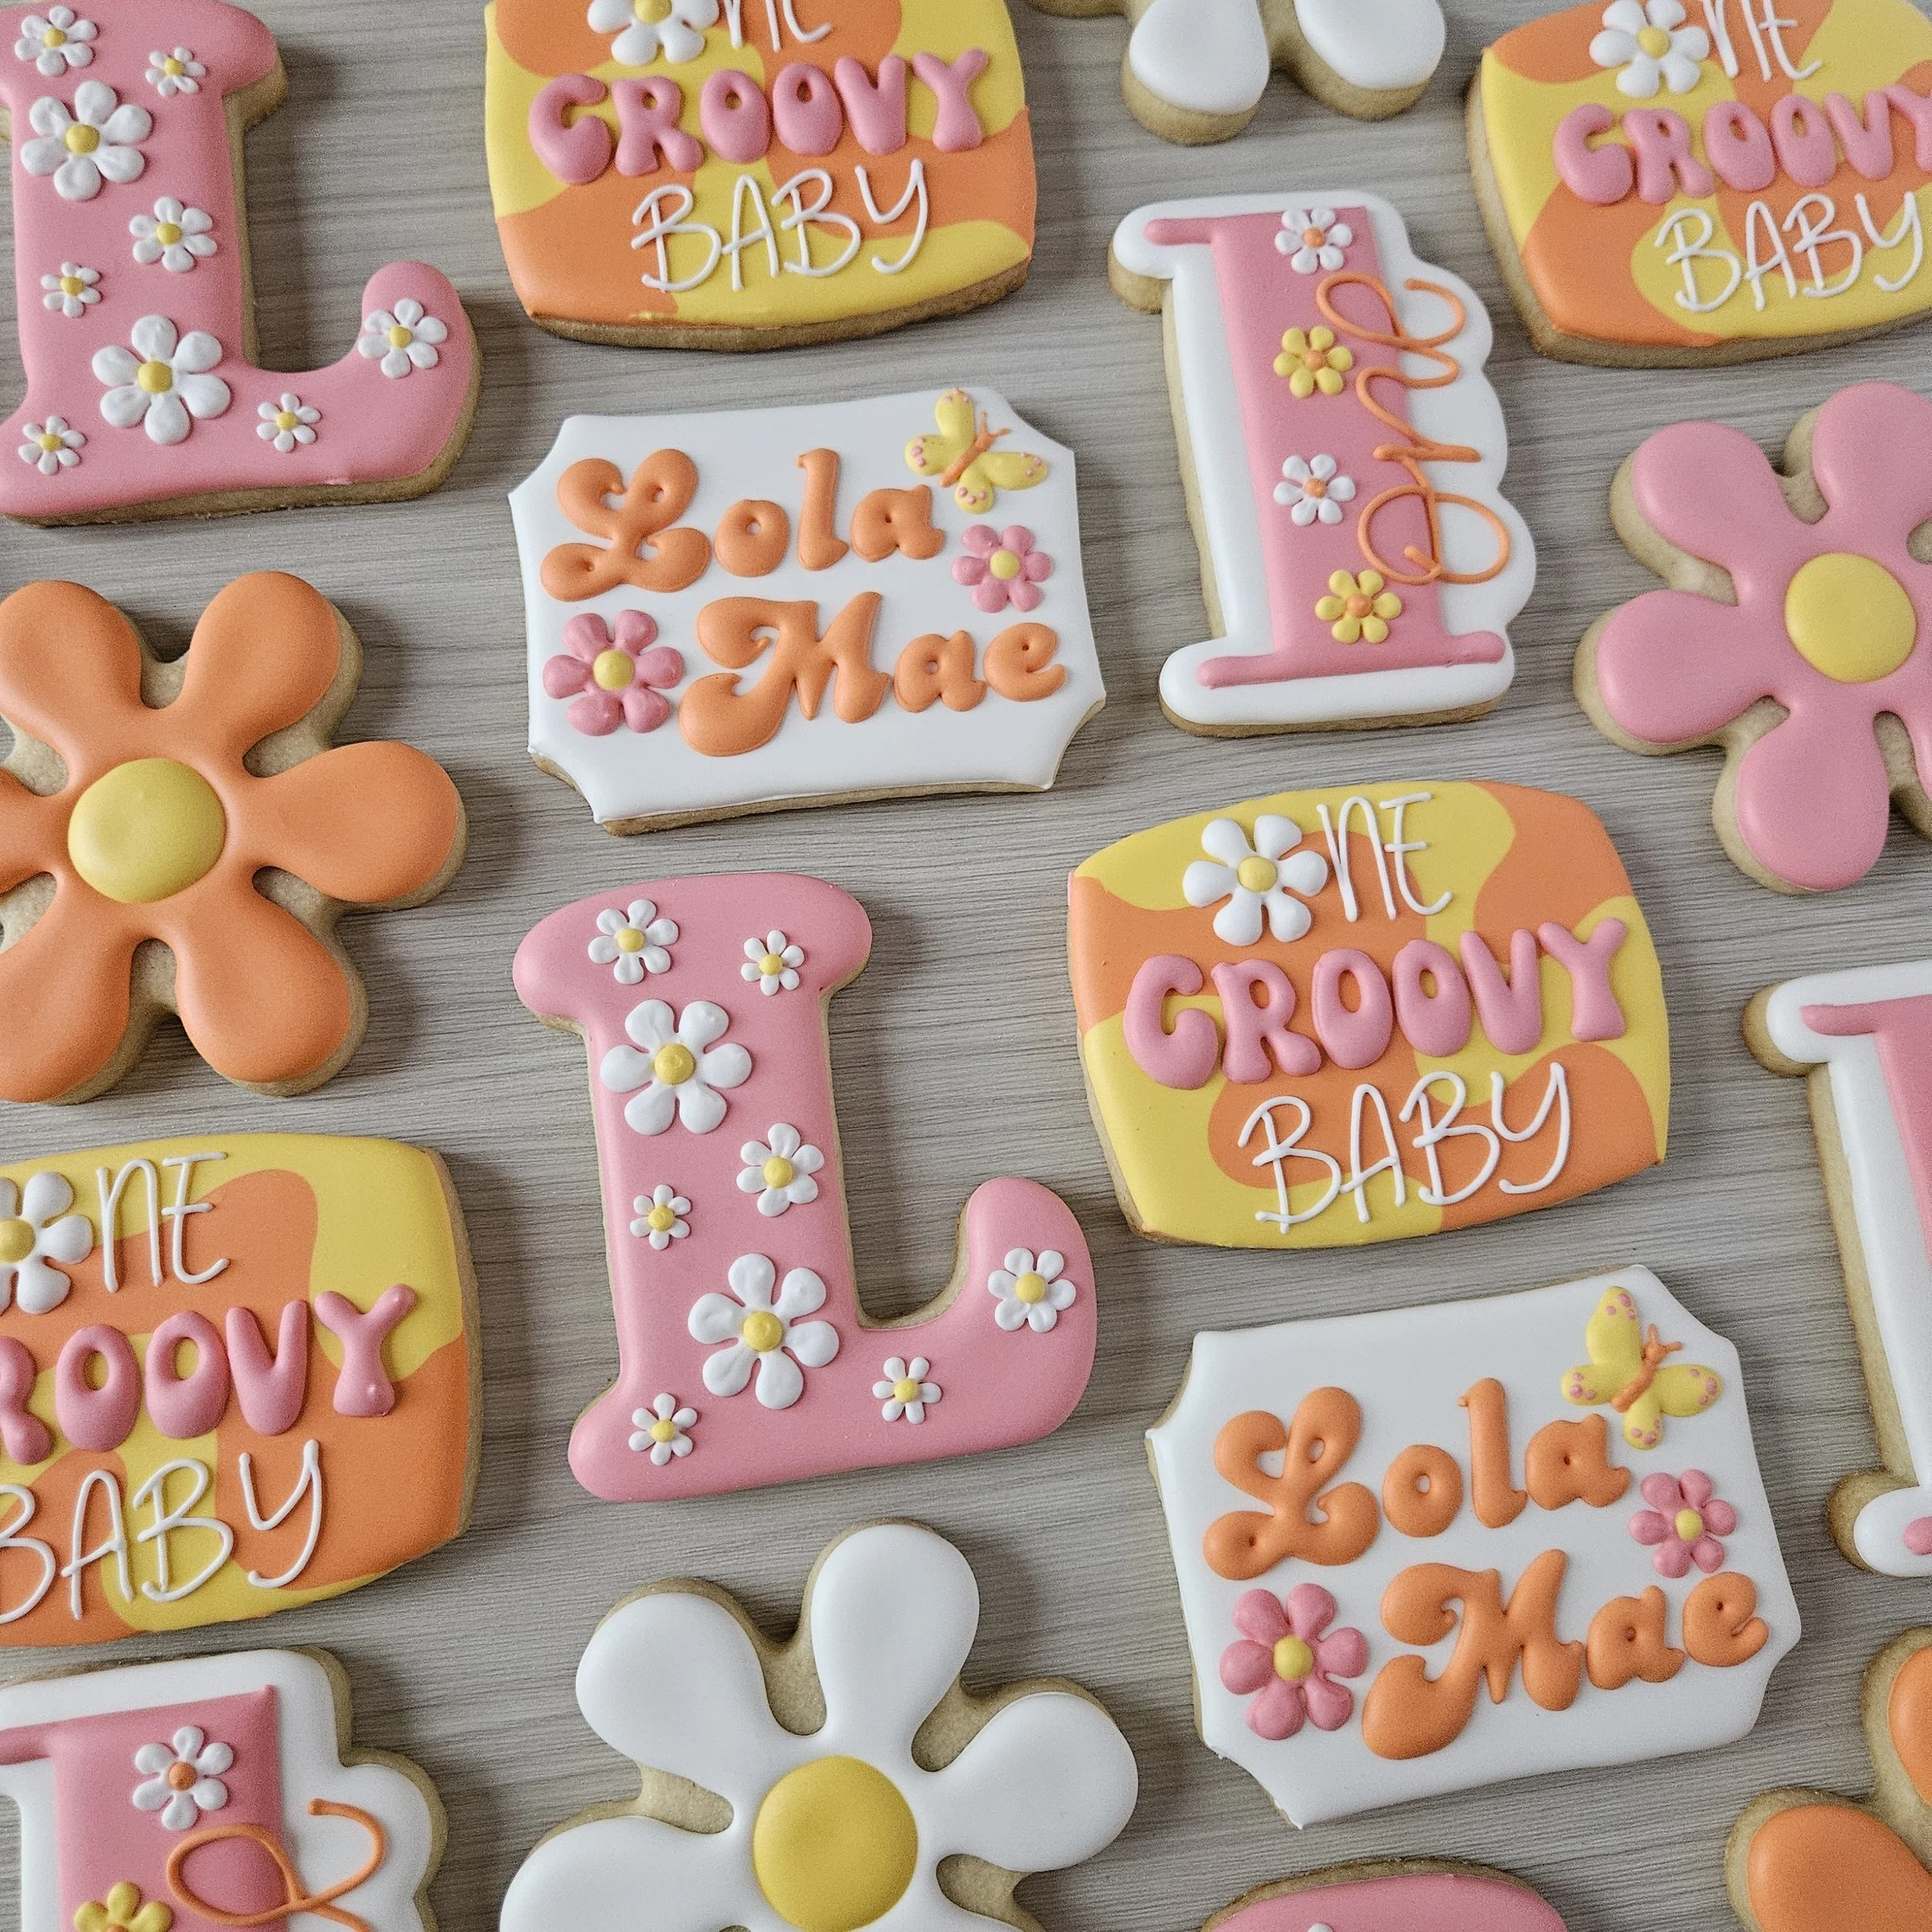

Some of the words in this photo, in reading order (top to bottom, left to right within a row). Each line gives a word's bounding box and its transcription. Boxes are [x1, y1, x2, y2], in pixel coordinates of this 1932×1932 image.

[528, 47, 989, 185] GROOVY
[631, 158, 929, 292] BABY
[1655, 191, 1923, 313] BABY
[539, 447, 946, 603] Lola
[678, 590, 1067, 757] Mae
[1122, 917, 1627, 1090] GROOVY
[1237, 1061, 1572, 1234] BABY
[1202, 1377, 1631, 1581] Lola
[1361, 1548, 1770, 1761] Mae
